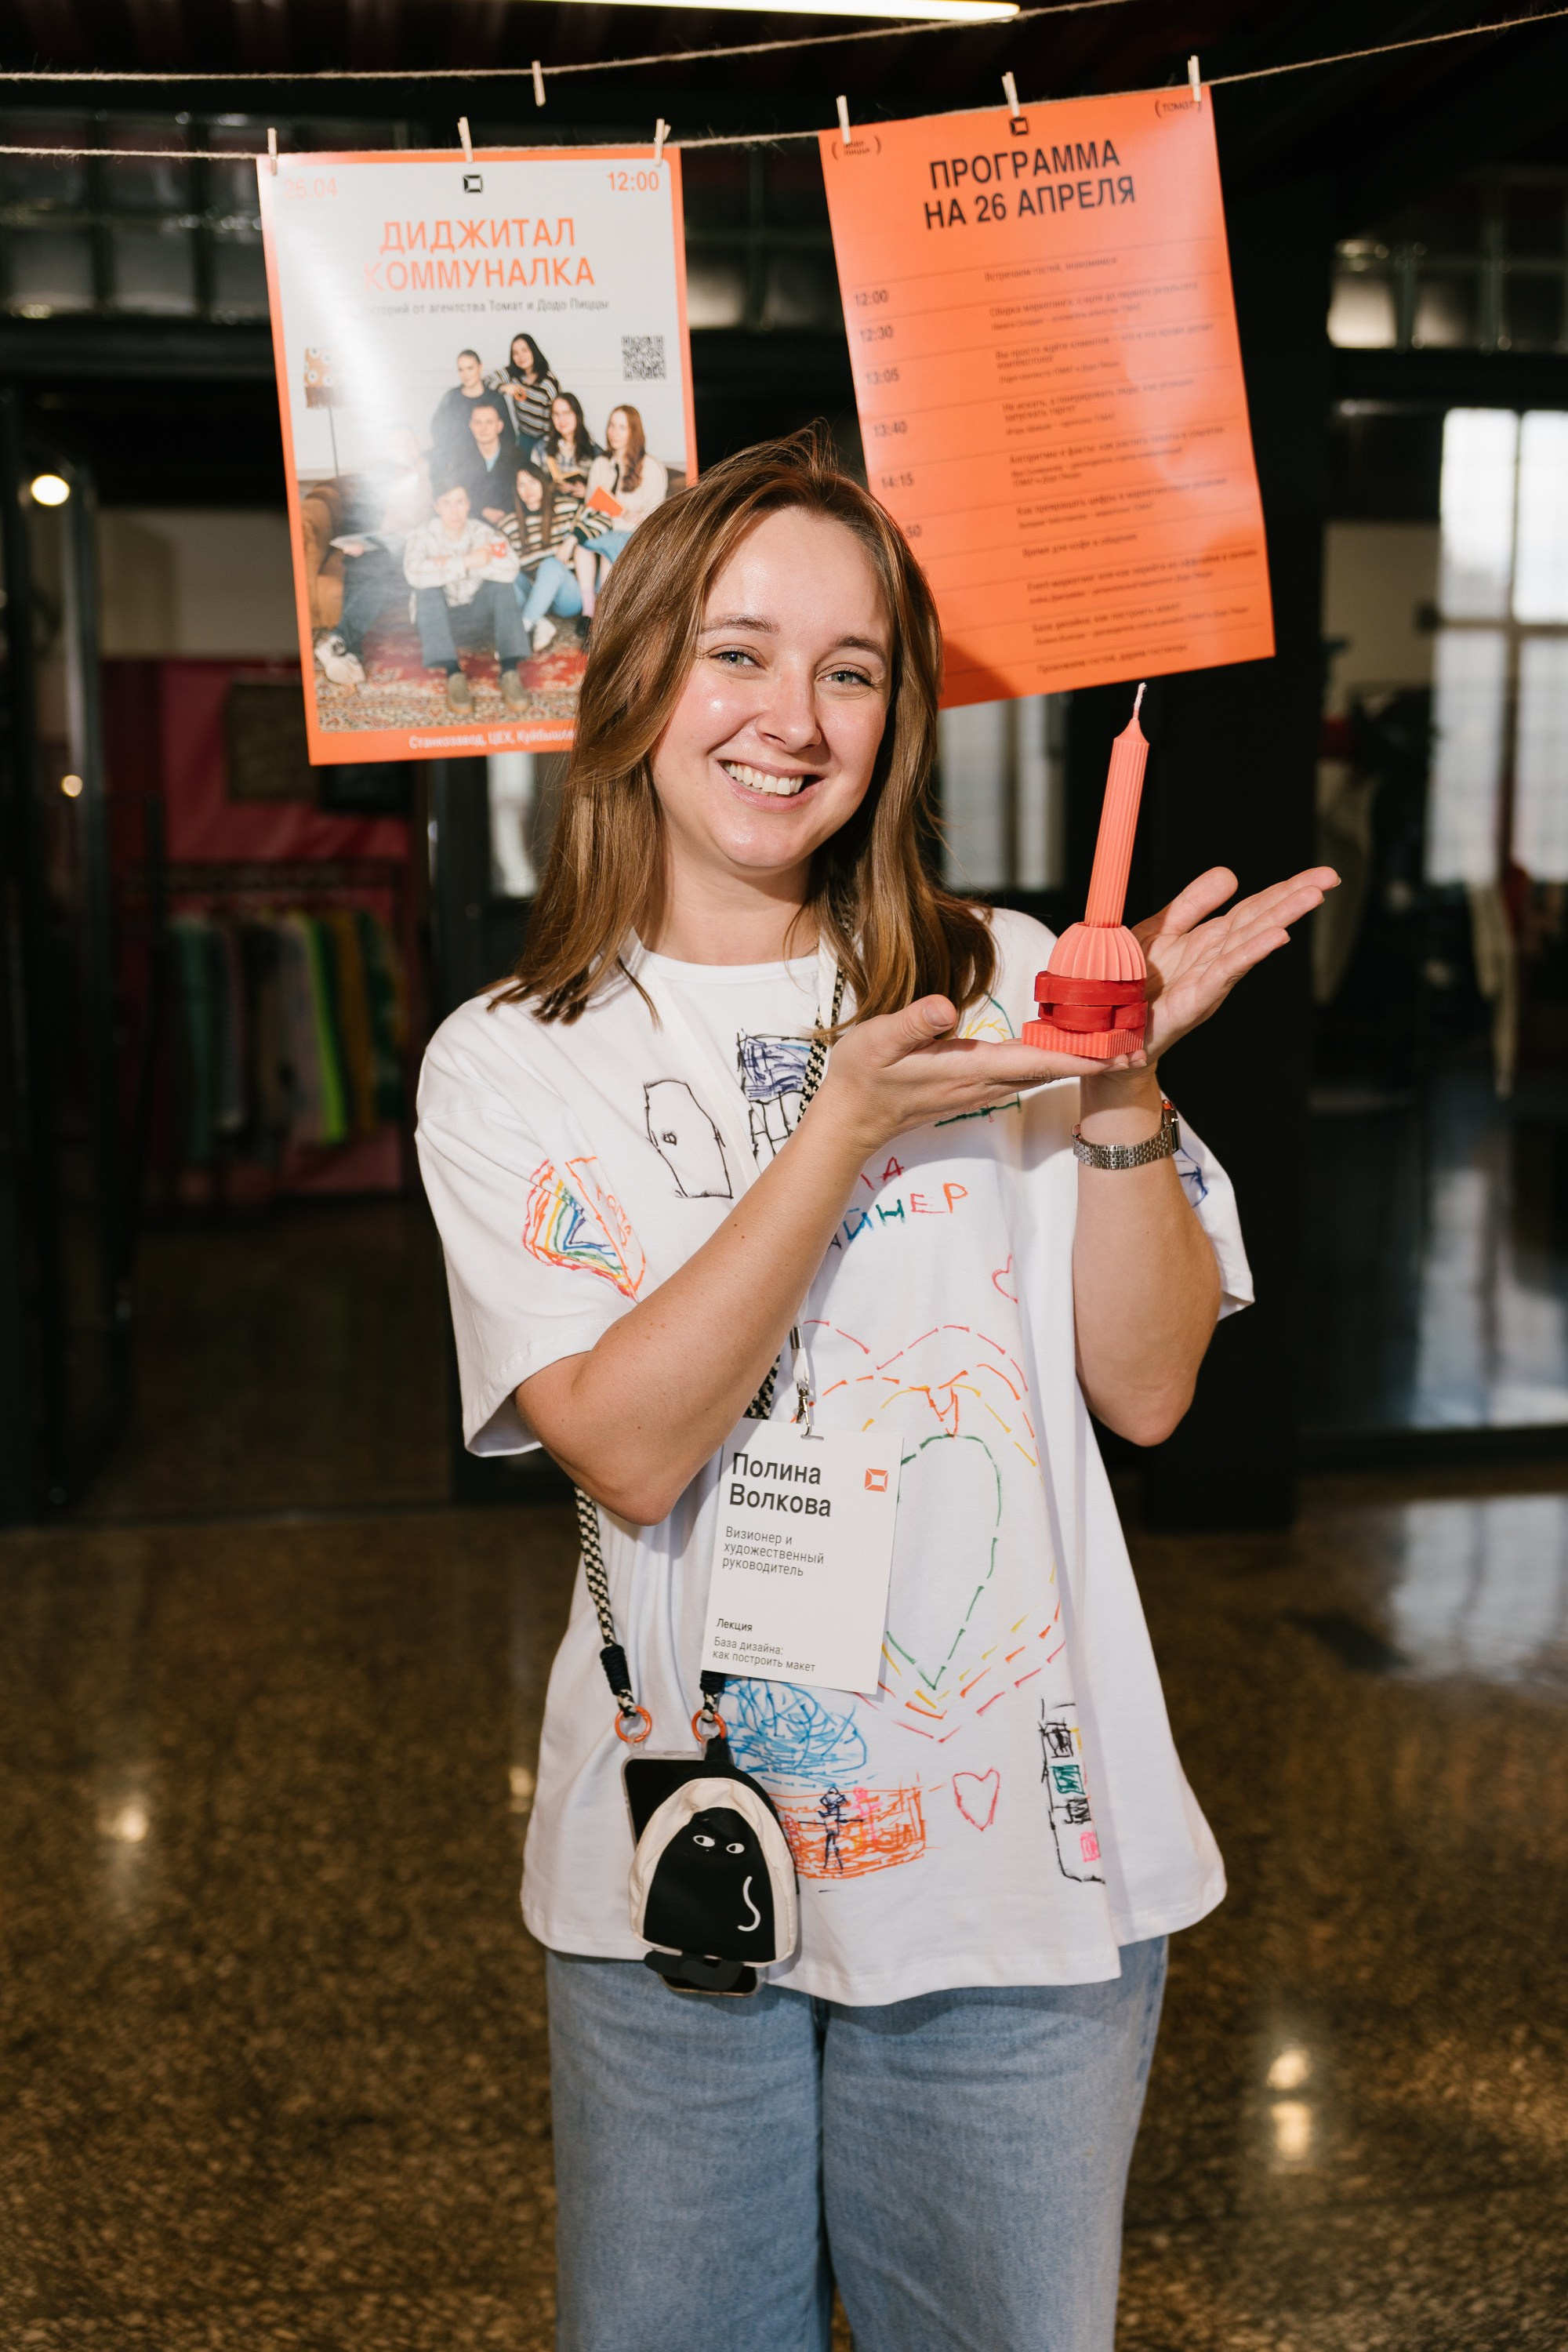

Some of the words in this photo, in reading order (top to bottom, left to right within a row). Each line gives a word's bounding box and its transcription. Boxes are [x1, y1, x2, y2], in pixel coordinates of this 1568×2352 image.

[929, 139, 1120, 191] ПРОГРАММА
[283, 176, 339, 201] 26.04
[607, 171, 660, 192] 12:00
[924, 194, 967, 230] НА
[975, 194, 1007, 224] 26
[1017, 175, 1136, 218] АПРЕЛЯ
[379, 217, 577, 256] ДИДЖИТАЛ
[363, 256, 596, 292] КОММУНАЛКА
[488, 299, 524, 313] Томат
[536, 298, 567, 313] Додо
[855, 289, 889, 307] 12:00
[860, 325, 895, 343] 12:30
[866, 368, 900, 386] 13:05
[873, 421, 907, 438] 13:40
[880, 472, 914, 490] 14:15
[517, 728, 576, 746] Куйбышев
[731, 1452, 822, 1486] Полина
[729, 1483, 832, 1518] Волкова
[725, 1526, 782, 1545] Визионер
[785, 1534, 793, 1545] и
[724, 1542, 825, 1565] художественный
[722, 1557, 804, 1577] руководитель
[716, 1618, 753, 1633] Лекция
[713, 1636, 737, 1650] База
[739, 1641, 784, 1656] дизайна:
[712, 1650, 730, 1661] как
[731, 1653, 783, 1668] построить
[786, 1661, 816, 1673] макет
